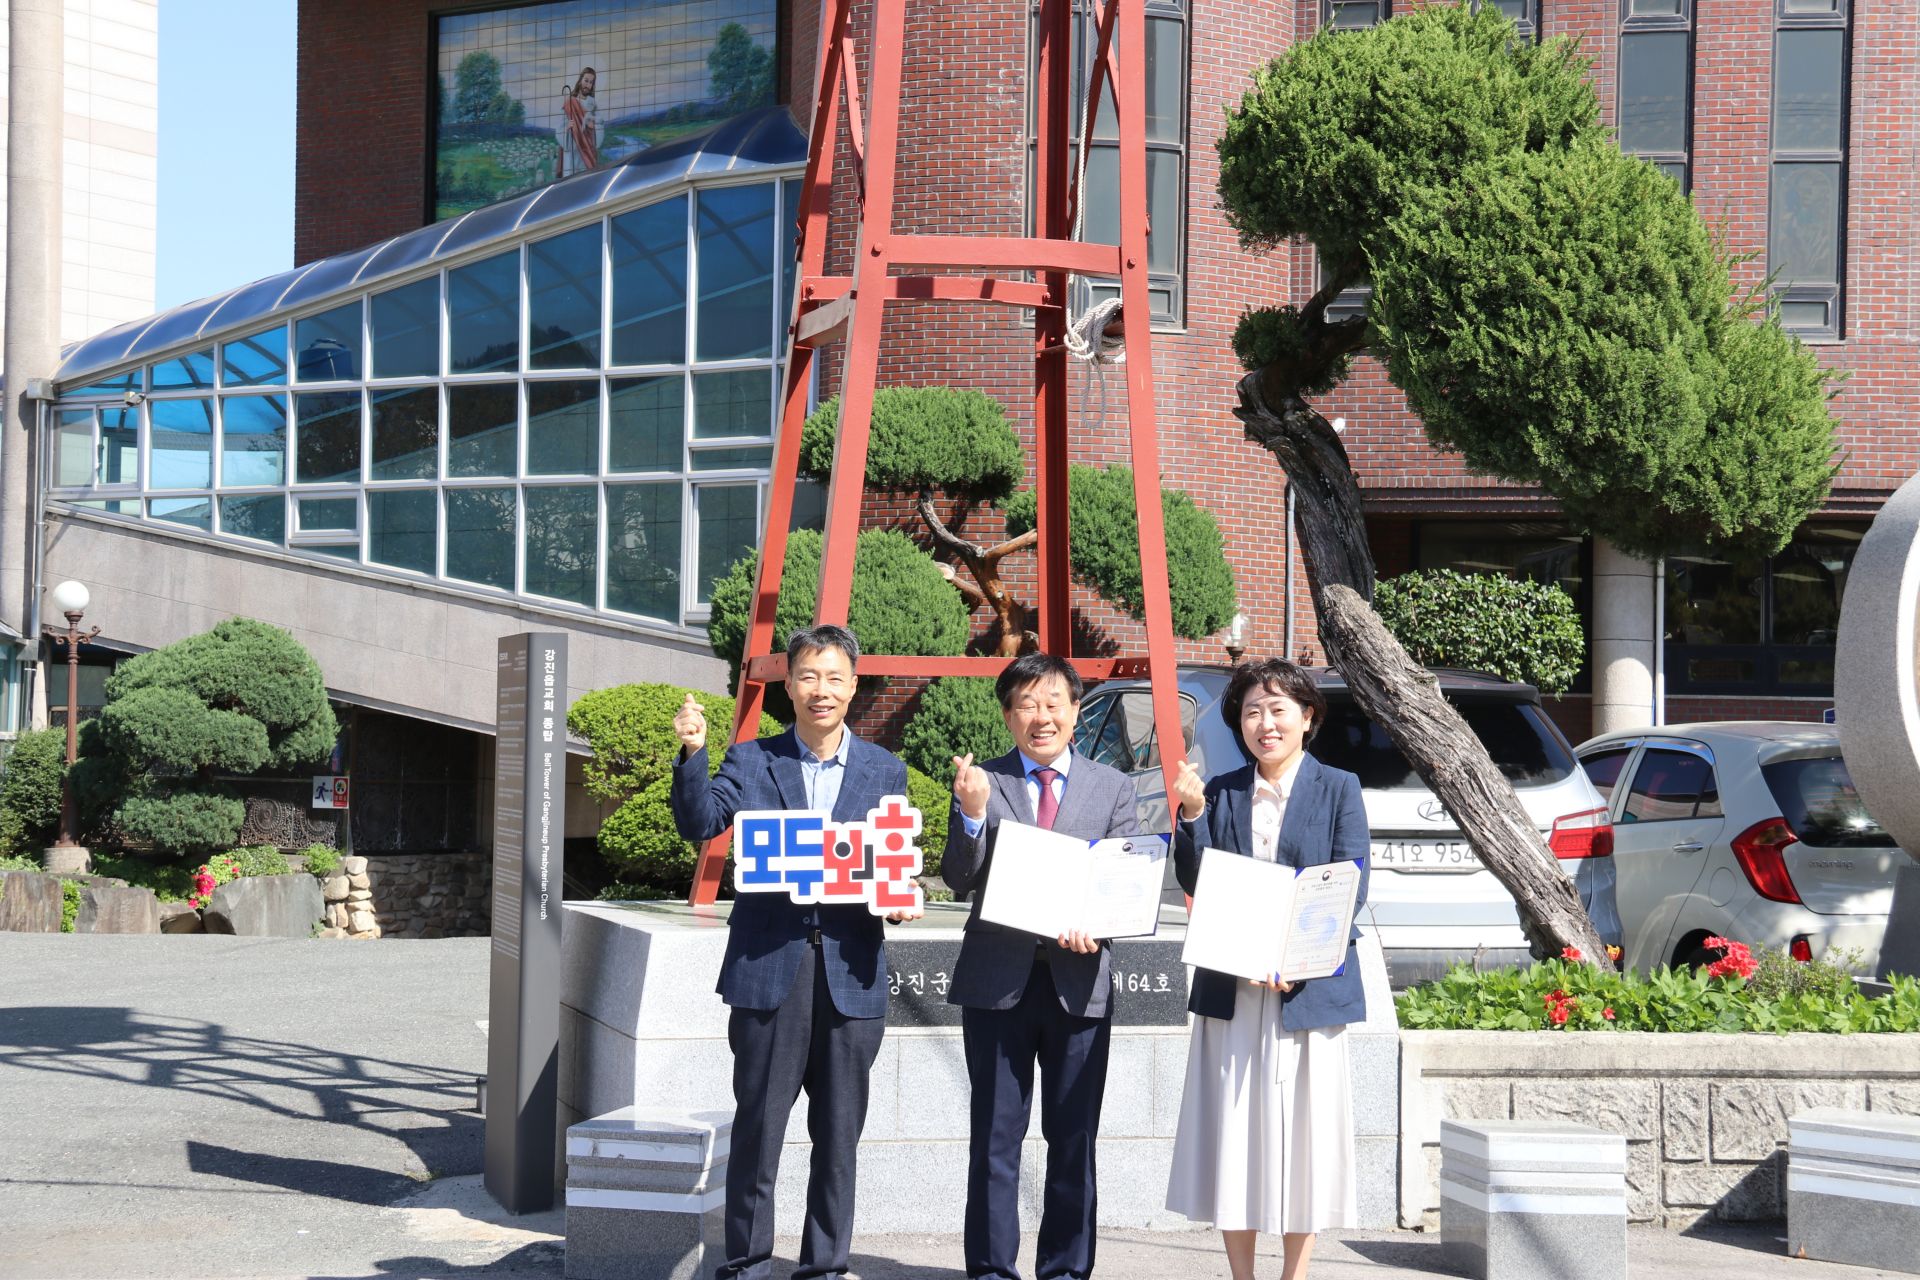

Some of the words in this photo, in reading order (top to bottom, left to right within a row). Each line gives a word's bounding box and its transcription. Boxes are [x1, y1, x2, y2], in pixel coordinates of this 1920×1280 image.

[544, 649, 556, 712] 강진읍교회
[543, 717, 554, 742] 종탑
[544, 752, 552, 767] Bell
[543, 767, 552, 791] Tower
[543, 791, 551, 800] of
[541, 801, 551, 844] Gangjineup
[1381, 842, 1424, 863] 41오
[540, 845, 550, 892] Presbyterian
[540, 893, 549, 920] Church
